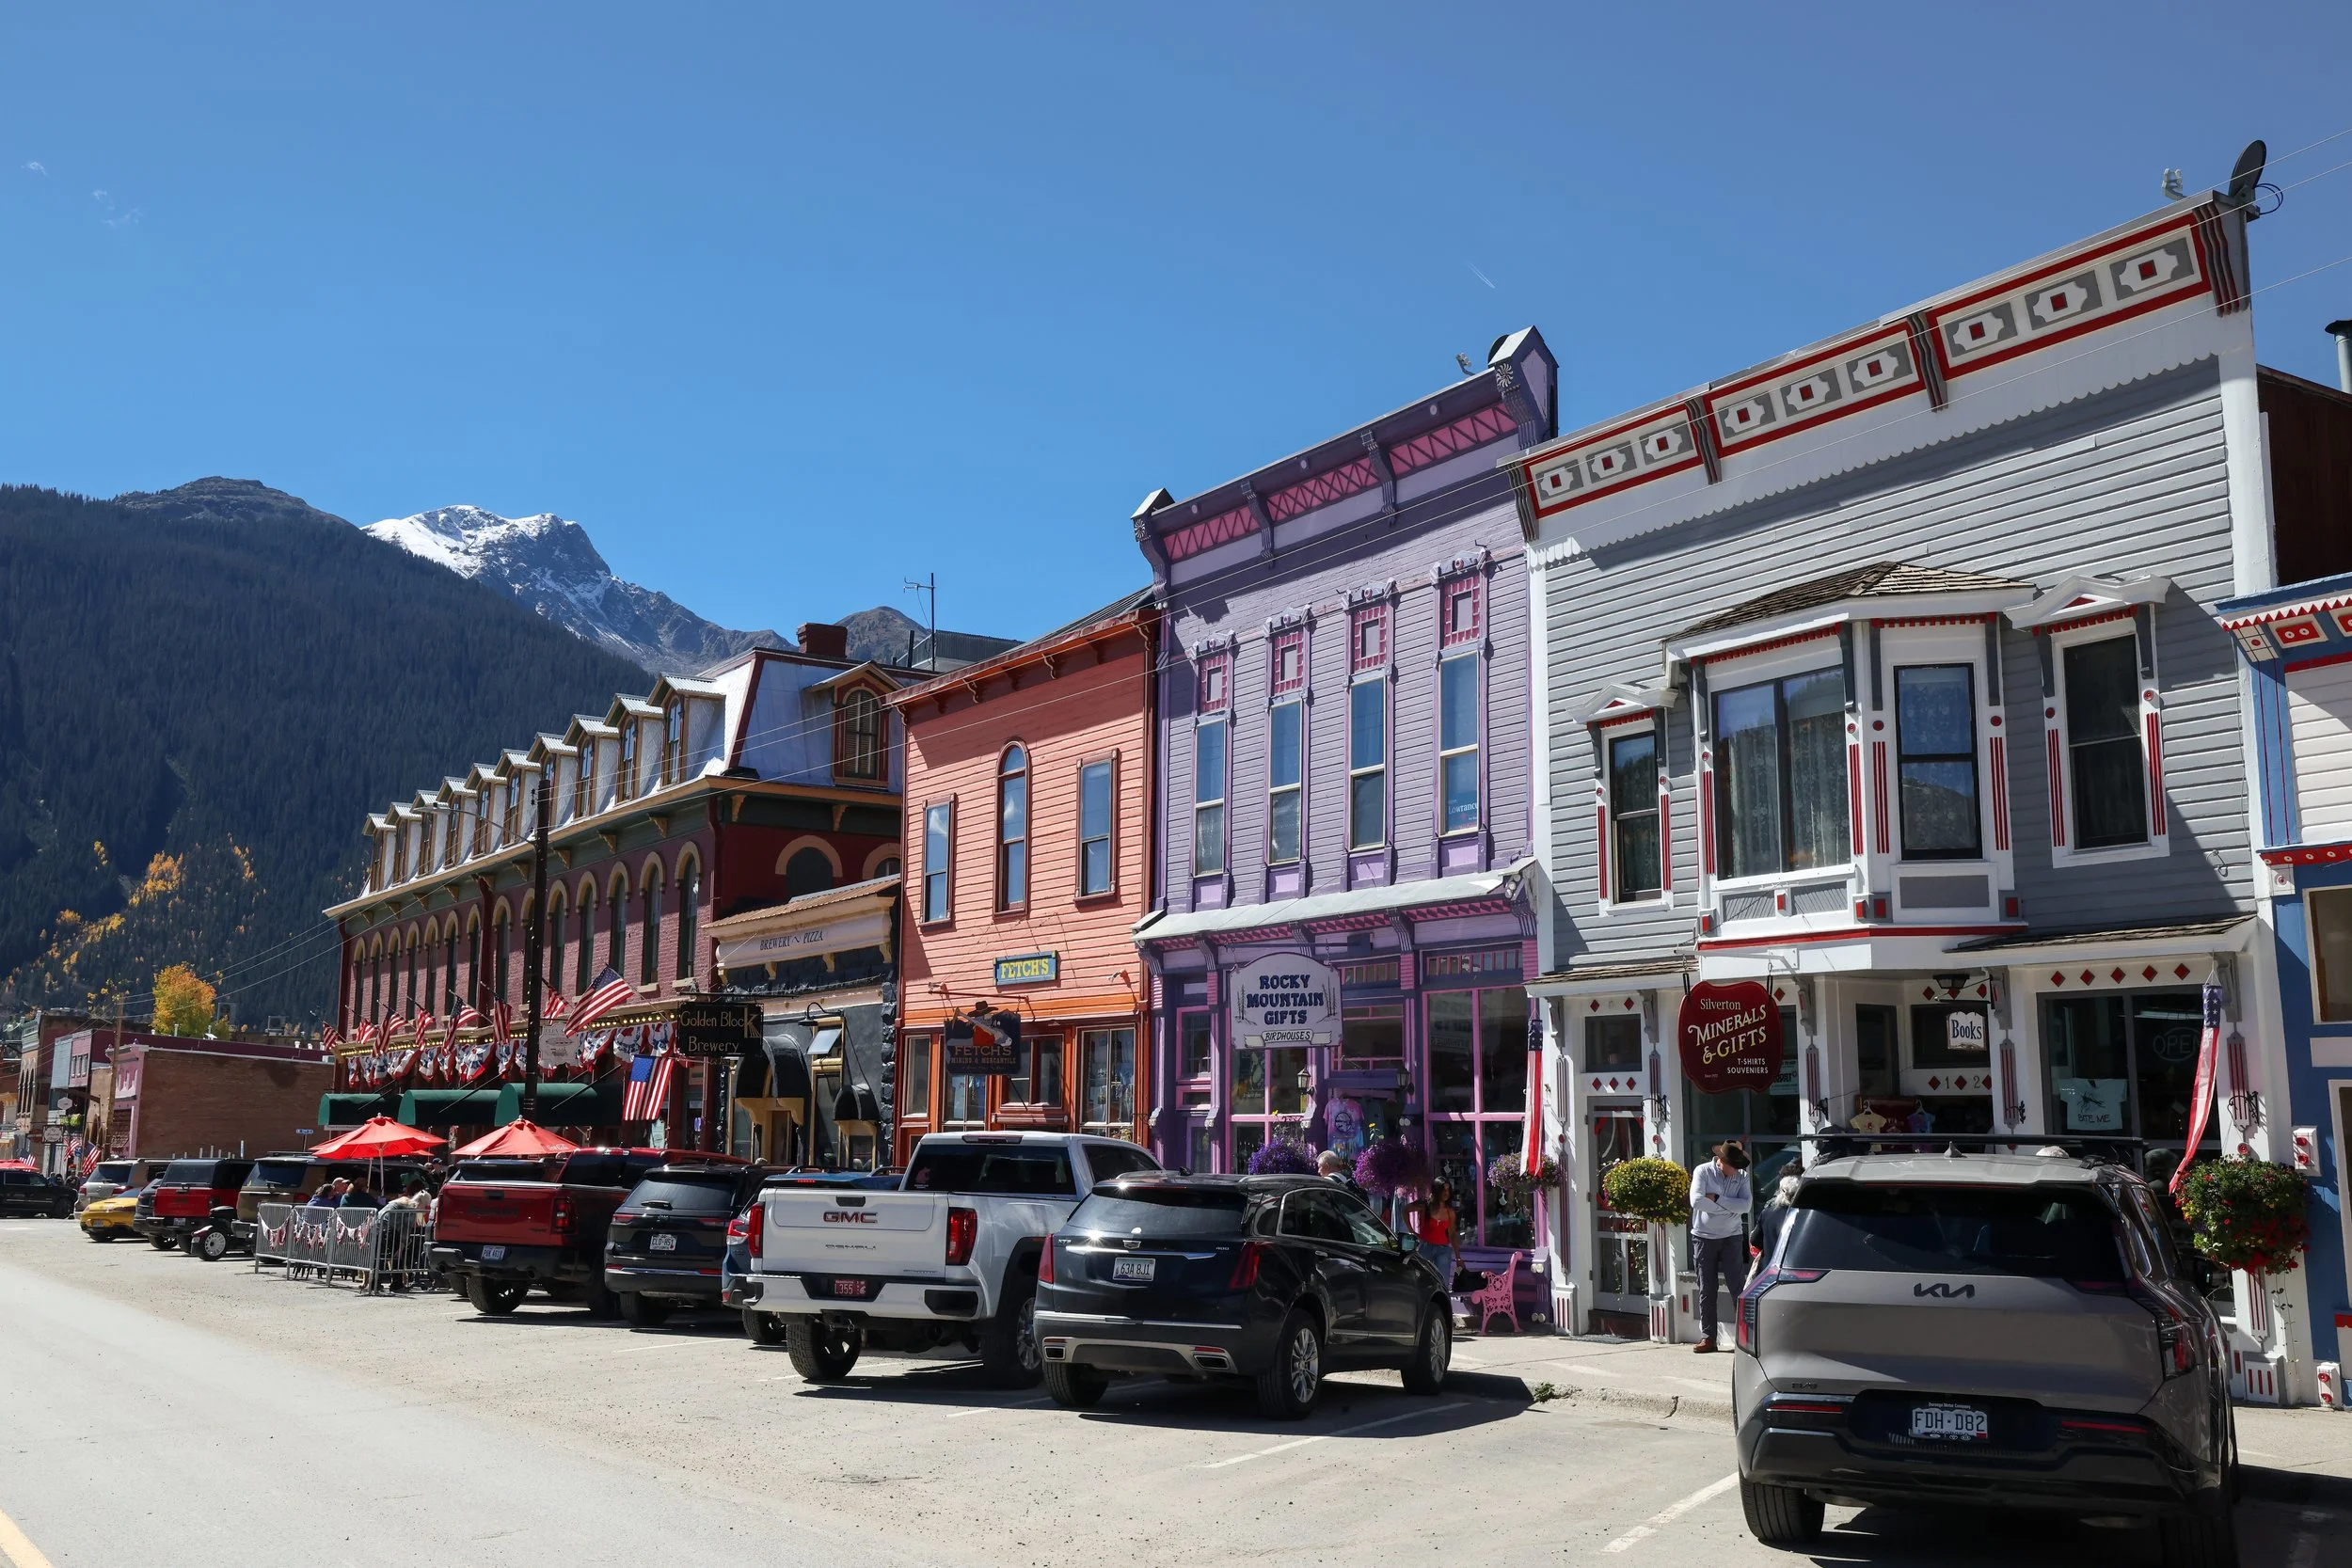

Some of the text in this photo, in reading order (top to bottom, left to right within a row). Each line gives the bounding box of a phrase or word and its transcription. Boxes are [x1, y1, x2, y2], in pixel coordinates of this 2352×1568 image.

[760, 930, 823, 951] BREWERY PIZZA
[1000, 958, 1049, 979] FETCH'S
[1259, 974, 1311, 990] ROCKY
[1247, 992, 1325, 1008] MOUNTAIN
[1700, 998, 1740, 1010] Silverton
[680, 1010, 717, 1027] Golden
[1263, 1009, 1308, 1025] GIFTS
[1688, 1005, 1767, 1046] MINERALS
[1951, 1019, 1982, 1039] Books
[689, 1036, 739, 1053] Brewery
[1264, 1031, 1311, 1042] BIRDHOUSES
[1717, 1026, 1767, 1057] GIFTS
[1973, 1075, 1980, 1088] 2
[2077, 1114, 2111, 1123] BITE ME
[823, 1211, 879, 1224] GMC
[1120, 1263, 1135, 1275] 63A
